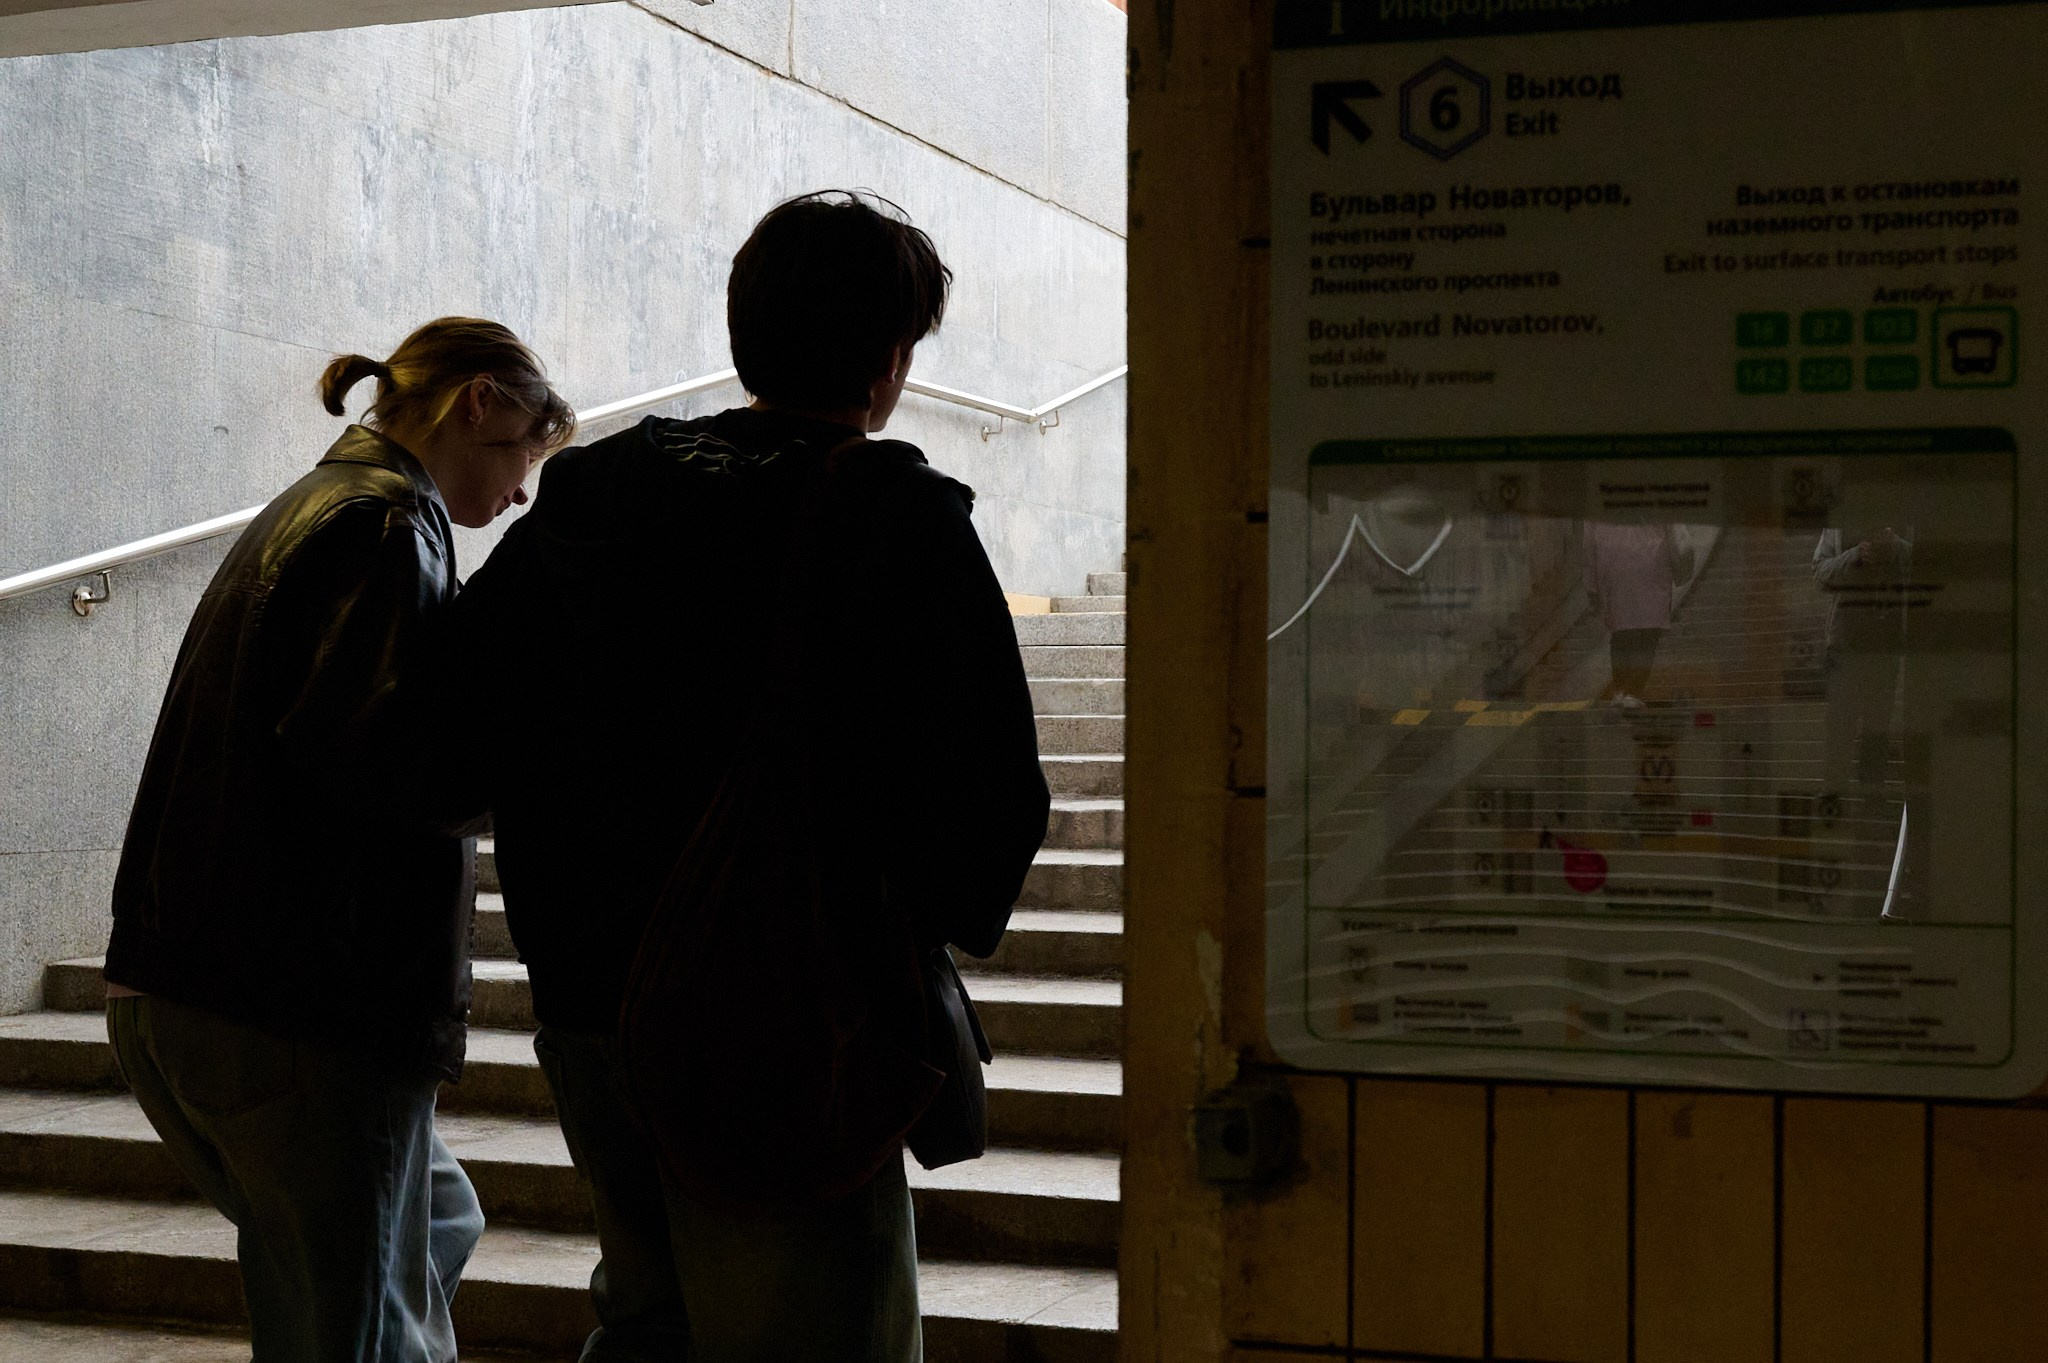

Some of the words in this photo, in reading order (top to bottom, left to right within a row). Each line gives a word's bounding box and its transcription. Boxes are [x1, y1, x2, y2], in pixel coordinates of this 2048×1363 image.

[1506, 73, 1623, 100] Выход
[1429, 86, 1461, 132] 6
[1506, 109, 1559, 136] Exit
[1310, 191, 1437, 222] Бульвар
[1449, 183, 1631, 212] Новаторов,
[1736, 184, 1827, 206] Выход
[1832, 185, 1846, 201] к
[1853, 180, 2019, 201] остановкам
[1311, 227, 1411, 246] нечетная
[1416, 223, 1506, 243] сторона
[1706, 214, 1854, 236] наземного
[1861, 206, 2019, 234] транспорта
[1328, 251, 1415, 272] сторону
[1664, 253, 1707, 273] Exit
[1713, 254, 1738, 272] to
[1743, 247, 1830, 271] surface
[1835, 245, 1947, 270] transport
[1954, 243, 2019, 265] stops
[1310, 275, 1439, 295] Ленинского
[1443, 271, 1561, 294] проспекта
[1309, 313, 1441, 341] Boulevard
[1452, 313, 1604, 336] Novatorov,
[1308, 348, 1345, 366] odd
[1349, 346, 1387, 364] side
[1309, 372, 1329, 388] to
[1332, 369, 1420, 390] Leninskiy
[1424, 370, 1496, 385] avenue
